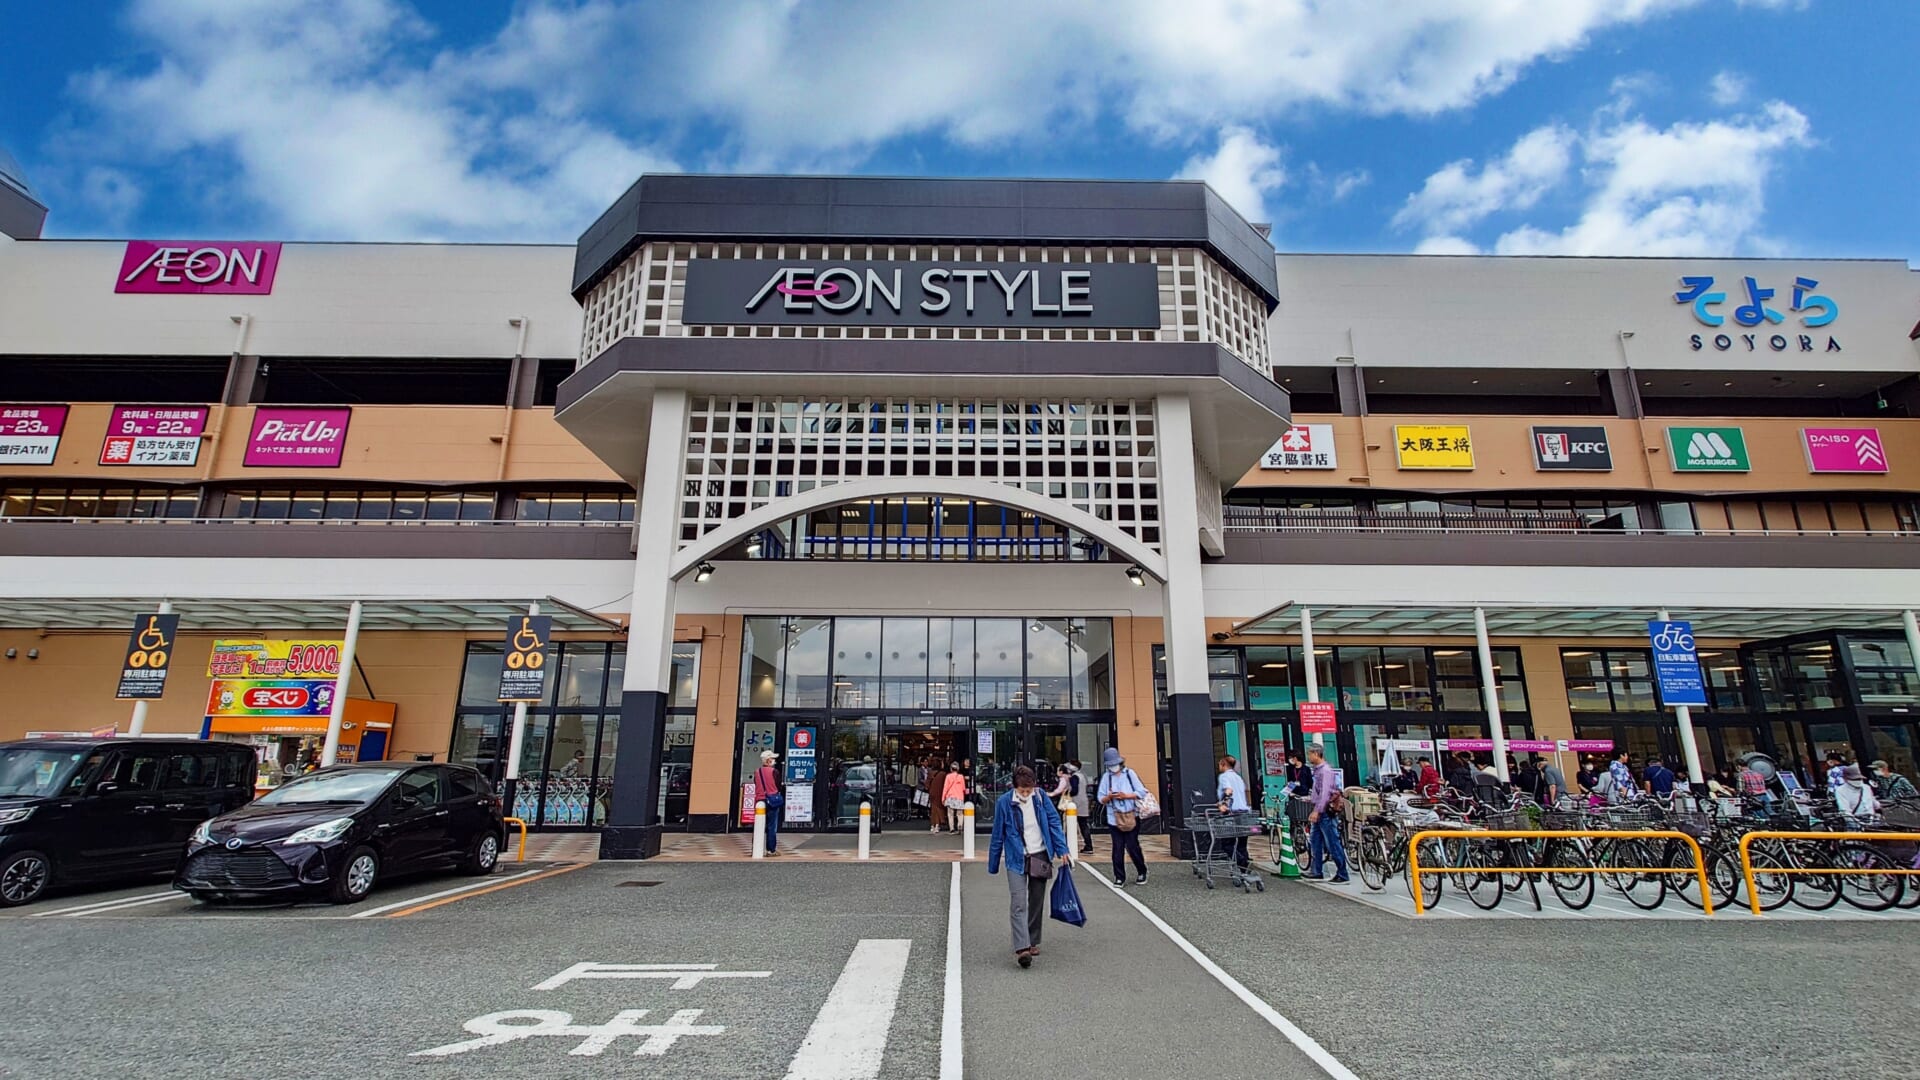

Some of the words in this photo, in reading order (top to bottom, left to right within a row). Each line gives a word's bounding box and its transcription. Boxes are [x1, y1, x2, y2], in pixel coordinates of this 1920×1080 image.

[919, 268, 1094, 313] STYLE
[1673, 276, 1839, 327] そよら
[1690, 334, 1842, 351] SOYORA
[106, 440, 132, 460] 薬
[136, 440, 196, 450] 処方せん受付
[1401, 437, 1470, 453] 大阪王将
[1570, 442, 1606, 454] KFC
[136, 451, 190, 461] イオン薬局
[1268, 453, 1328, 466] 宮脇書店
[252, 690, 299, 706] 宝くじ
